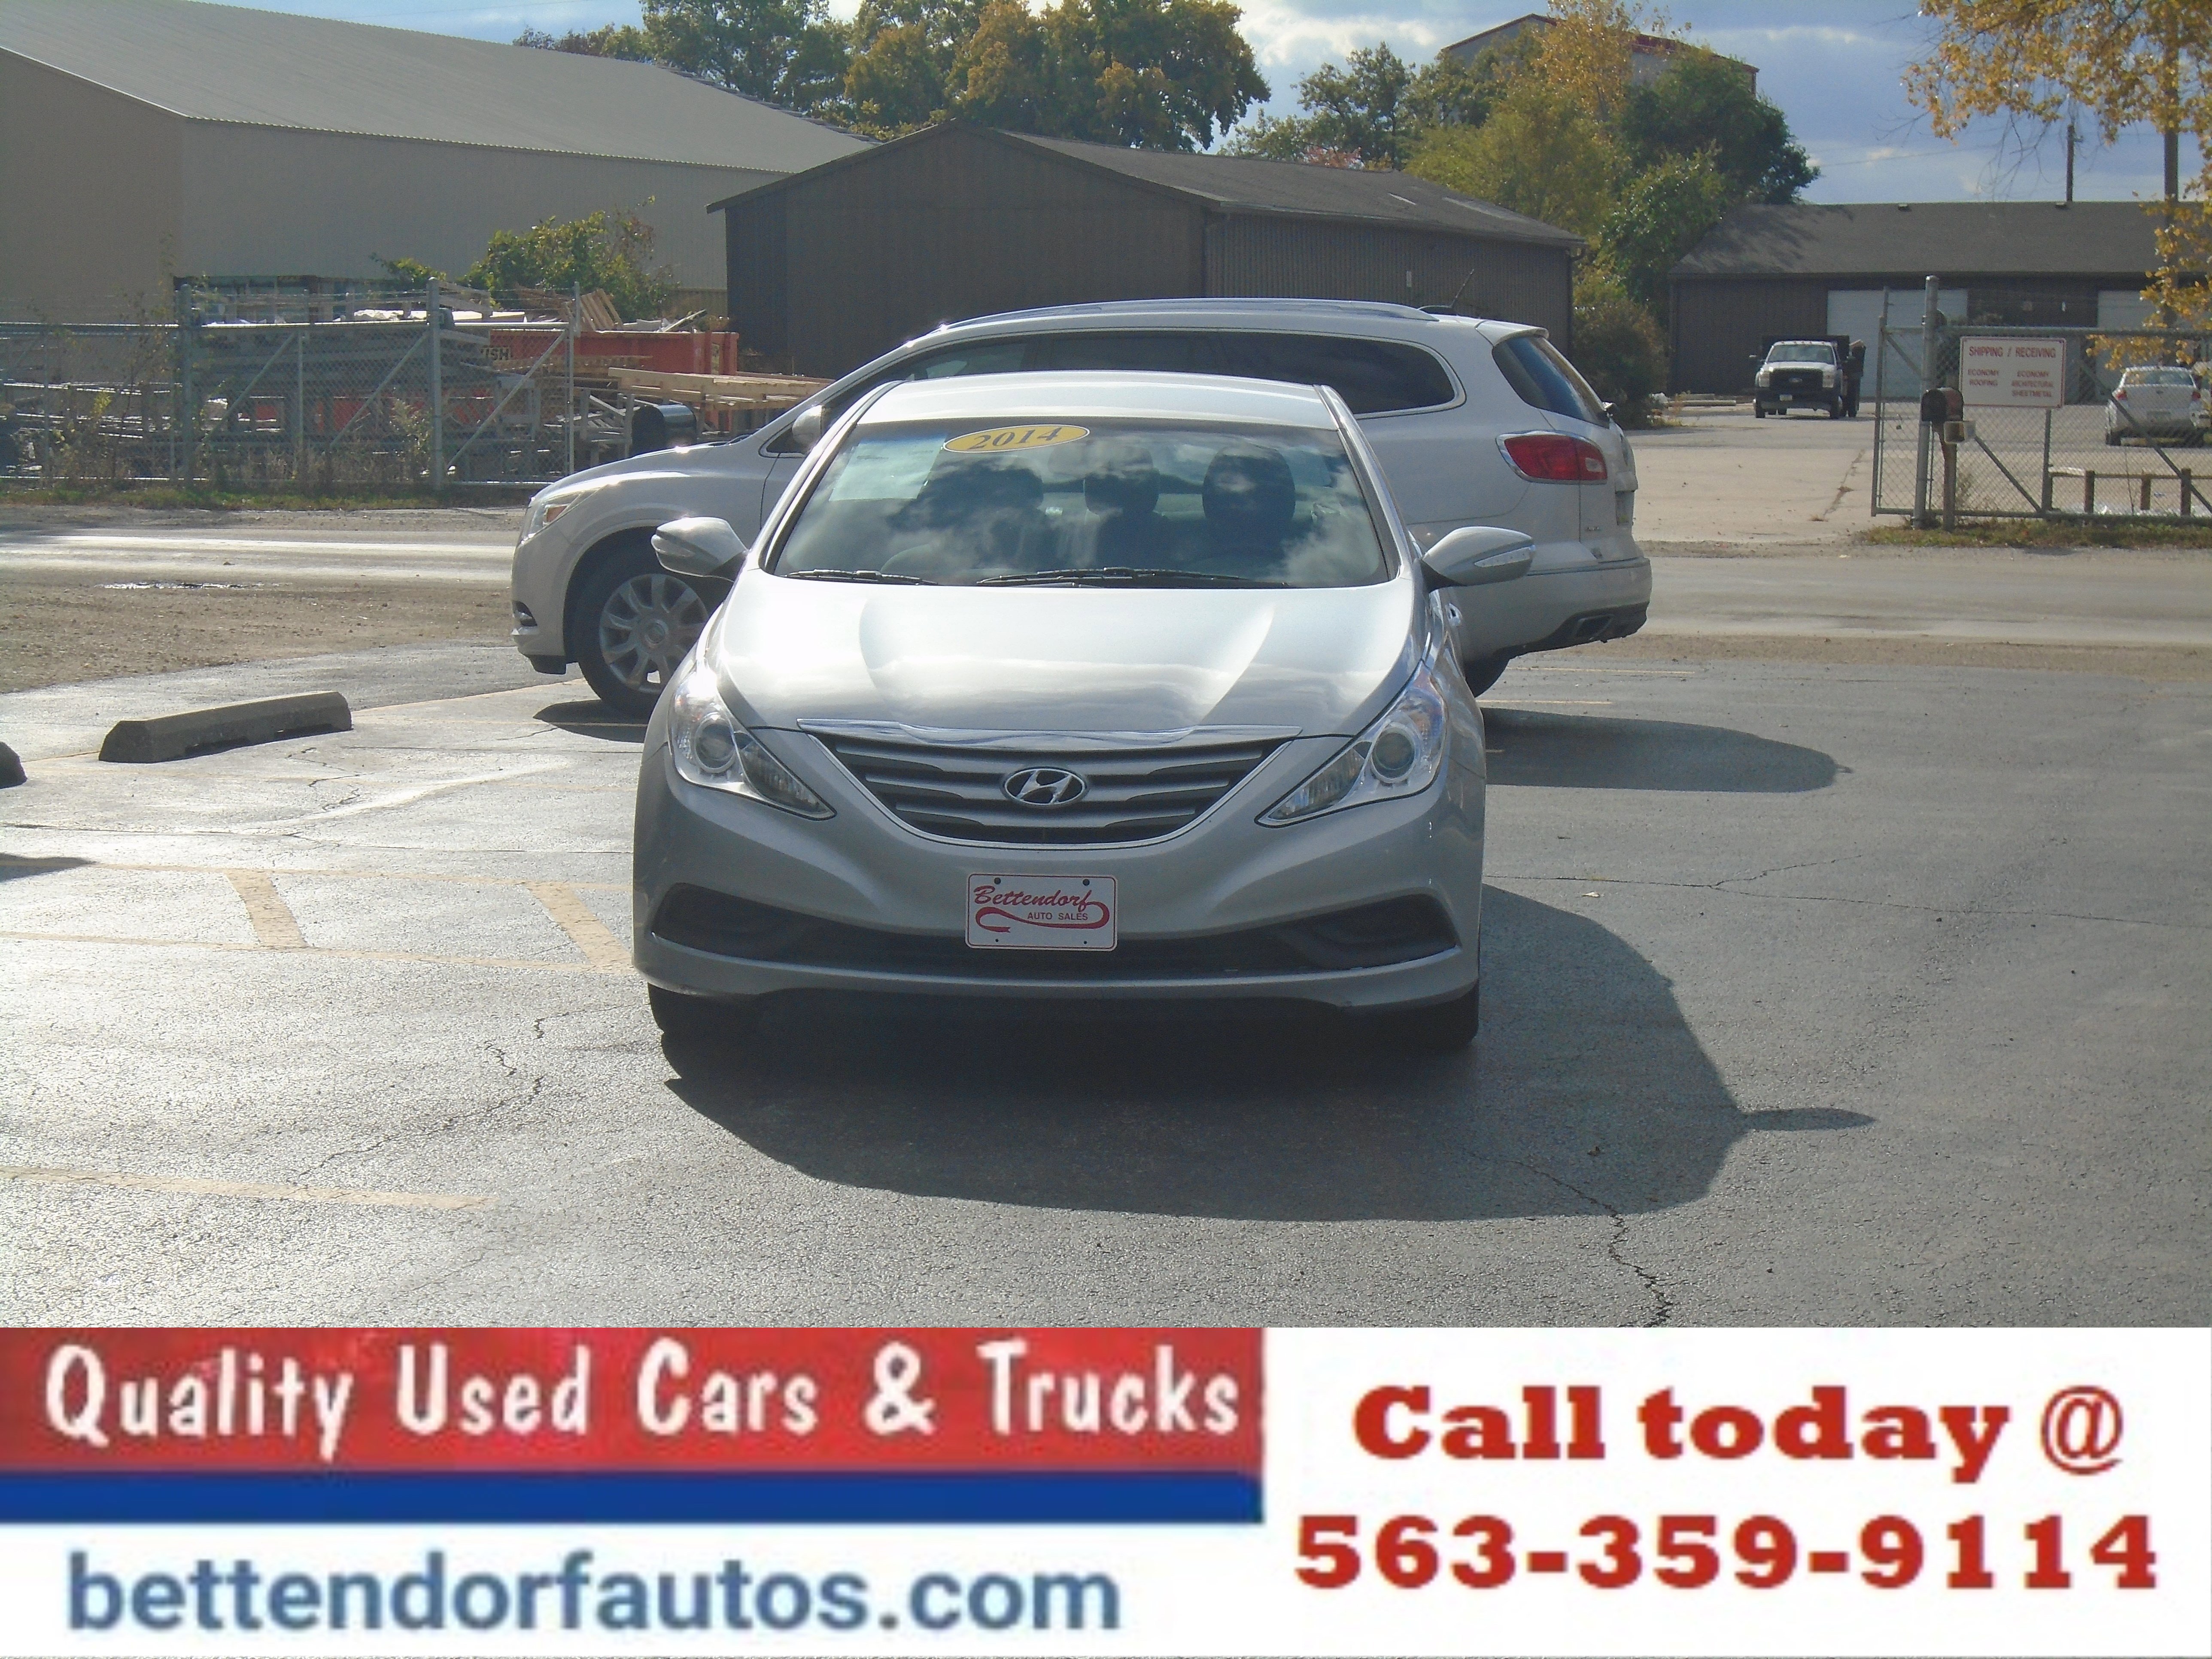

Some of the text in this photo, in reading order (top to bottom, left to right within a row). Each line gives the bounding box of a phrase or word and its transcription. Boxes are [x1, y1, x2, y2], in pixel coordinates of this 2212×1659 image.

[1969, 346, 2003, 357] SHIPPING
[2015, 347, 2056, 358] RECEIVING
[967, 427, 1062, 450] 2014
[973, 884, 1093, 912] Bettendorf
